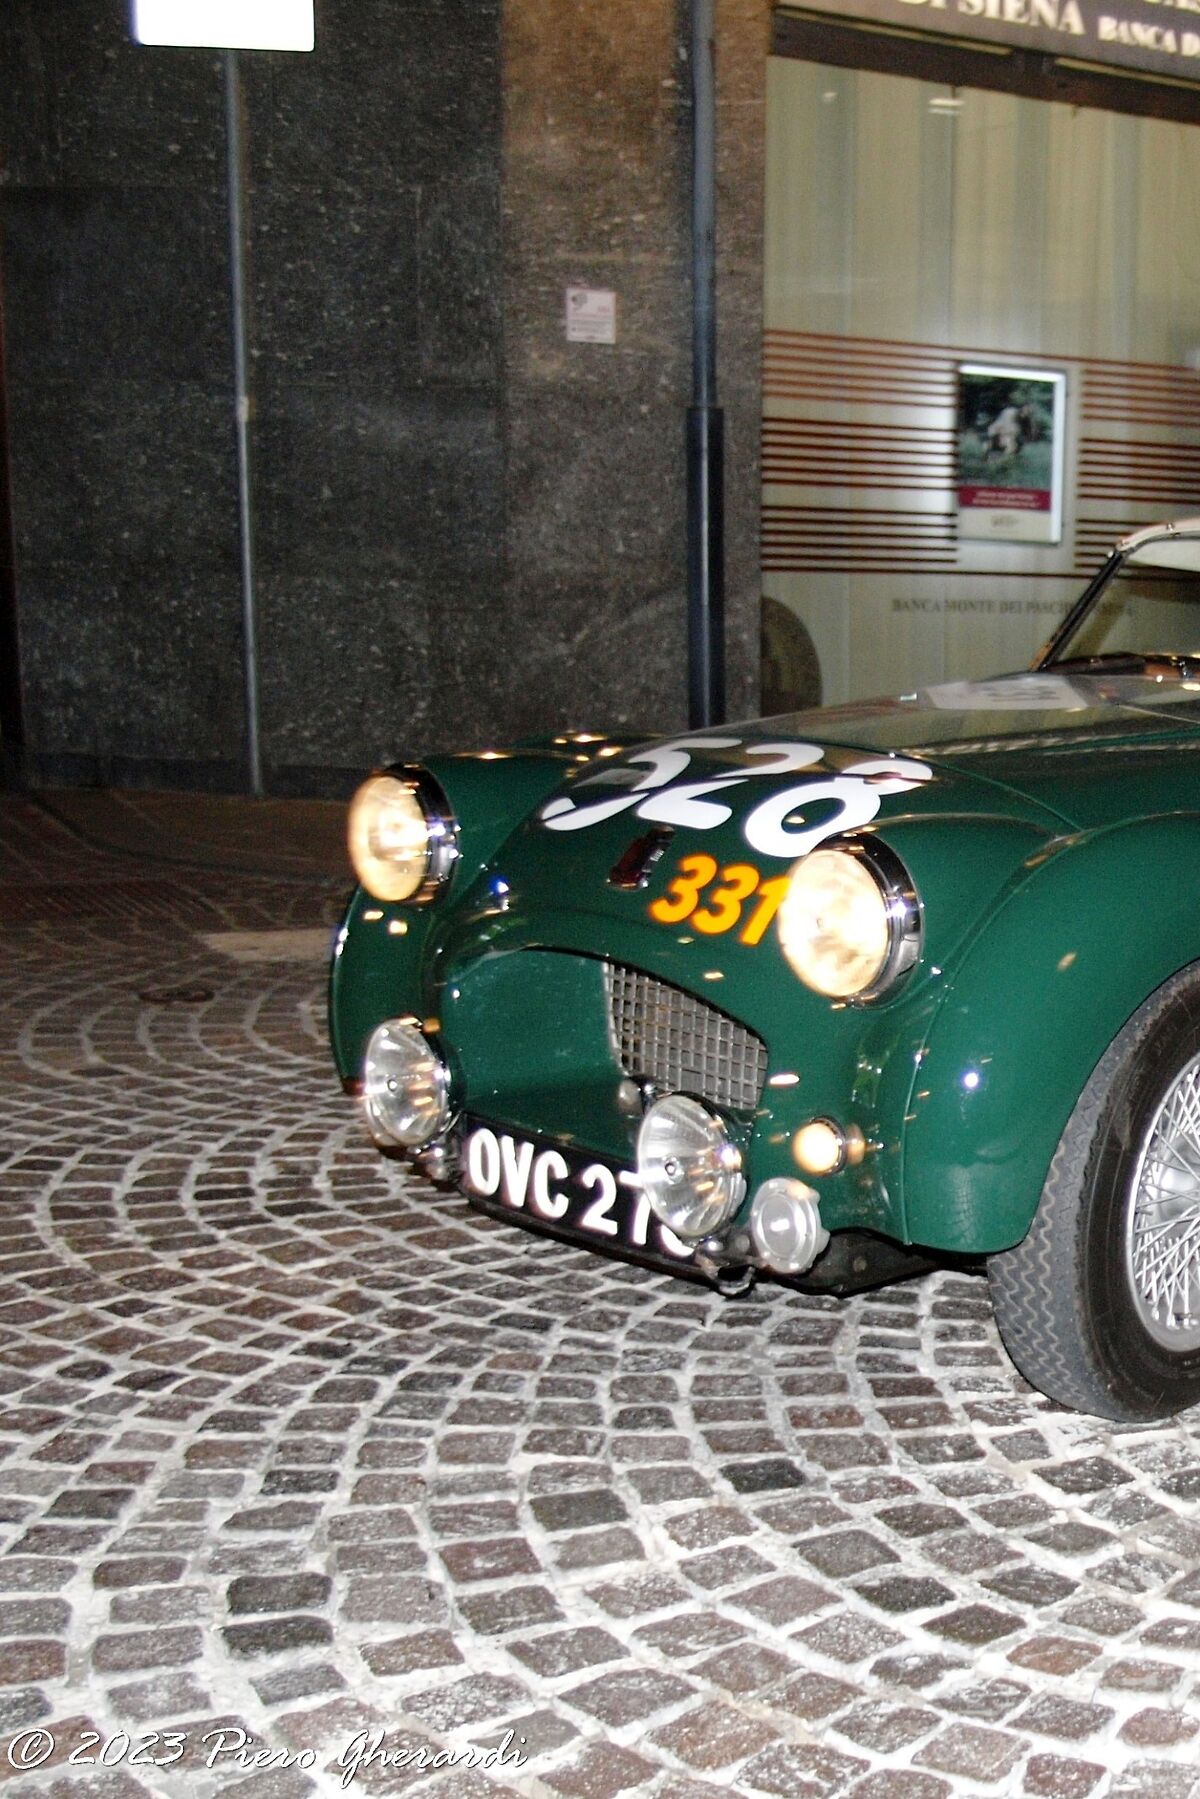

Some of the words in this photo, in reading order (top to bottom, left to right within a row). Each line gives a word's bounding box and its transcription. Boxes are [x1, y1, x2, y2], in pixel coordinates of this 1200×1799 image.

[1099, 15, 1177, 53] BANCA
[893, 598, 941, 613] BANCA
[541, 737, 934, 858] 528
[648, 852, 791, 947] 331
[467, 1128, 570, 1219] OVC
[580, 1164, 695, 1258] 27
